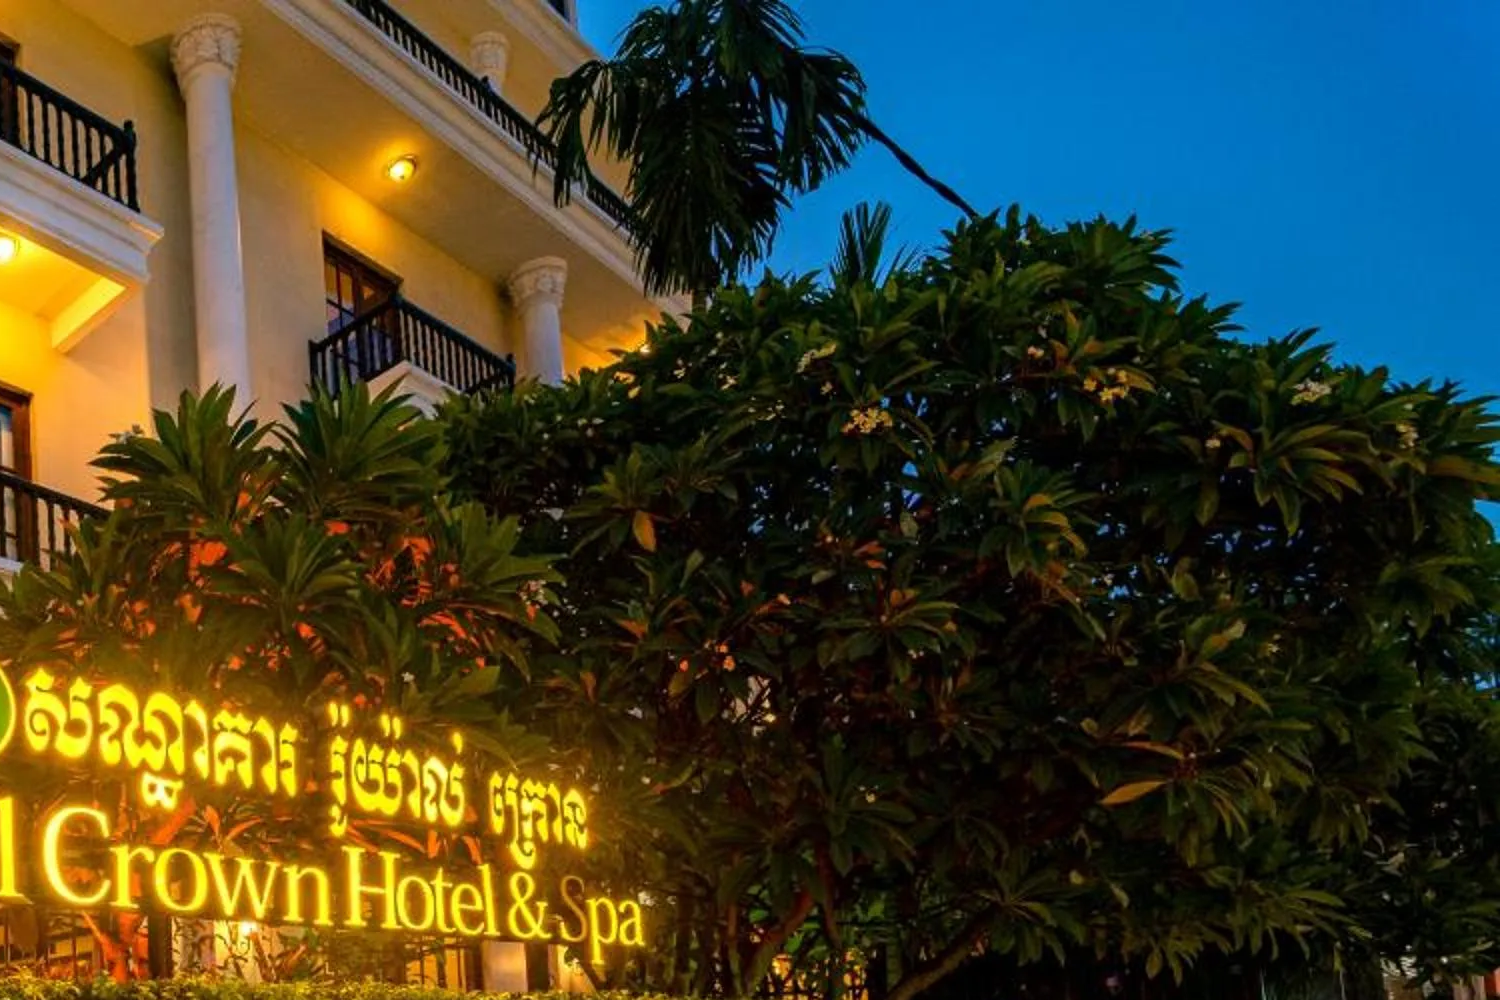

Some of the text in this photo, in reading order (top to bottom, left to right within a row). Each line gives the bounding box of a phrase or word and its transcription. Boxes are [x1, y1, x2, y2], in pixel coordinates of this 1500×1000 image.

[42, 806, 334, 927] Crown
[341, 845, 501, 937] Hotel
[507, 871, 552, 940] &
[555, 875, 646, 966] Spa
